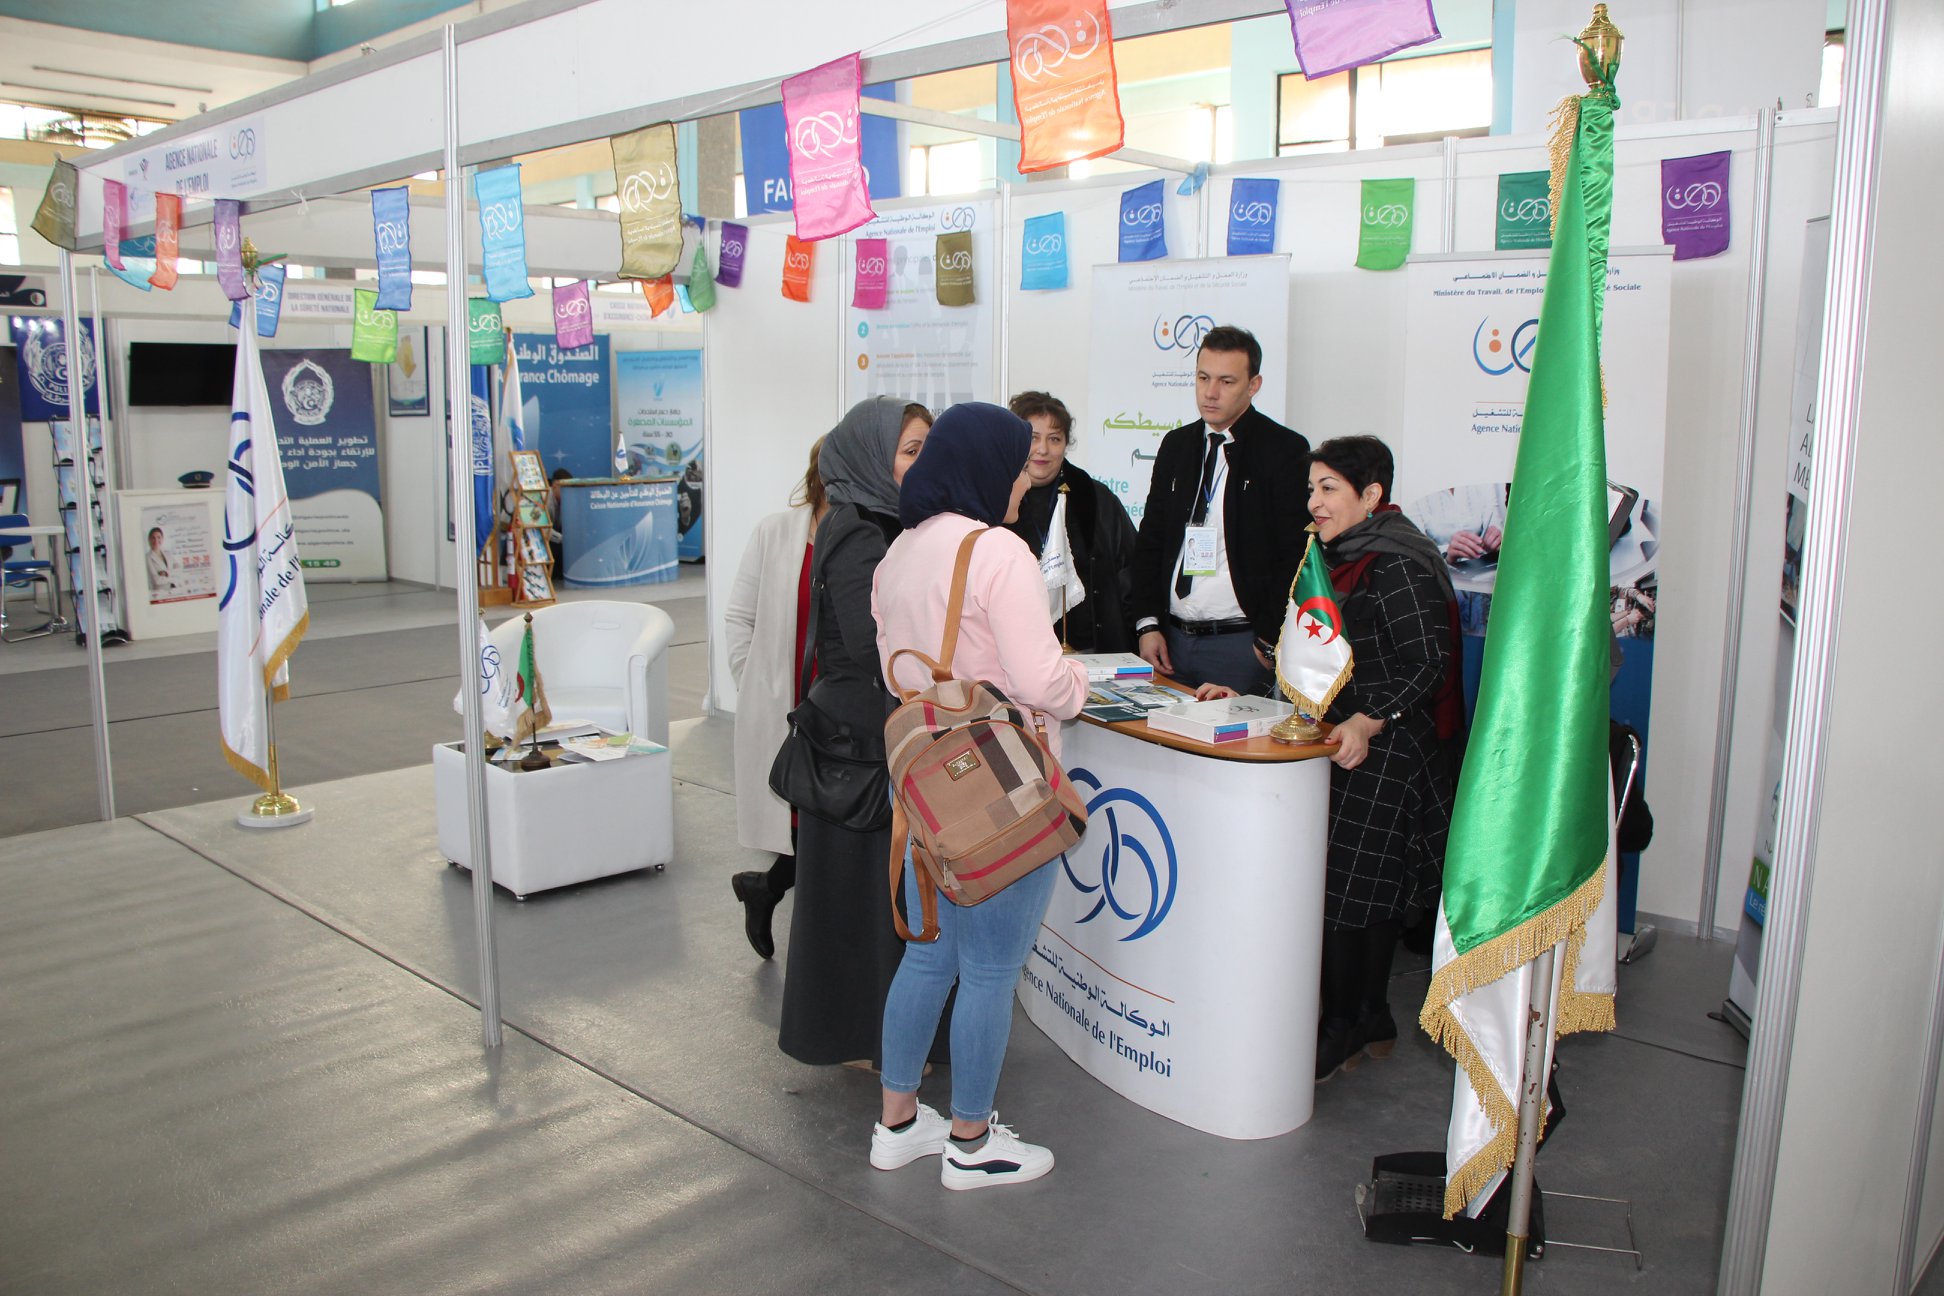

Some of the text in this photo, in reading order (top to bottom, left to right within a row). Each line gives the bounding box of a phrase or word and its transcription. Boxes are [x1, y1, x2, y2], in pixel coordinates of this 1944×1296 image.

[165, 139, 218, 171] AGENCE NATIONALE
[1433, 289, 1464, 297] Ministère
[1466, 288, 1475, 296] du
[1504, 287, 1514, 295] de
[1515, 286, 1544, 296] l'Emplo
[1613, 283, 1641, 291] Sociale
[546, 369, 600, 387] Chômage
[1471, 423, 1500, 435] Agence
[1092, 475, 1129, 494] otre
[277, 570, 296, 589] de
[1058, 957, 1100, 1002] الوطنية
[1021, 964, 1171, 1077] gence Nationale de l'Emploi
[1100, 990, 1170, 1038] الوكالة
